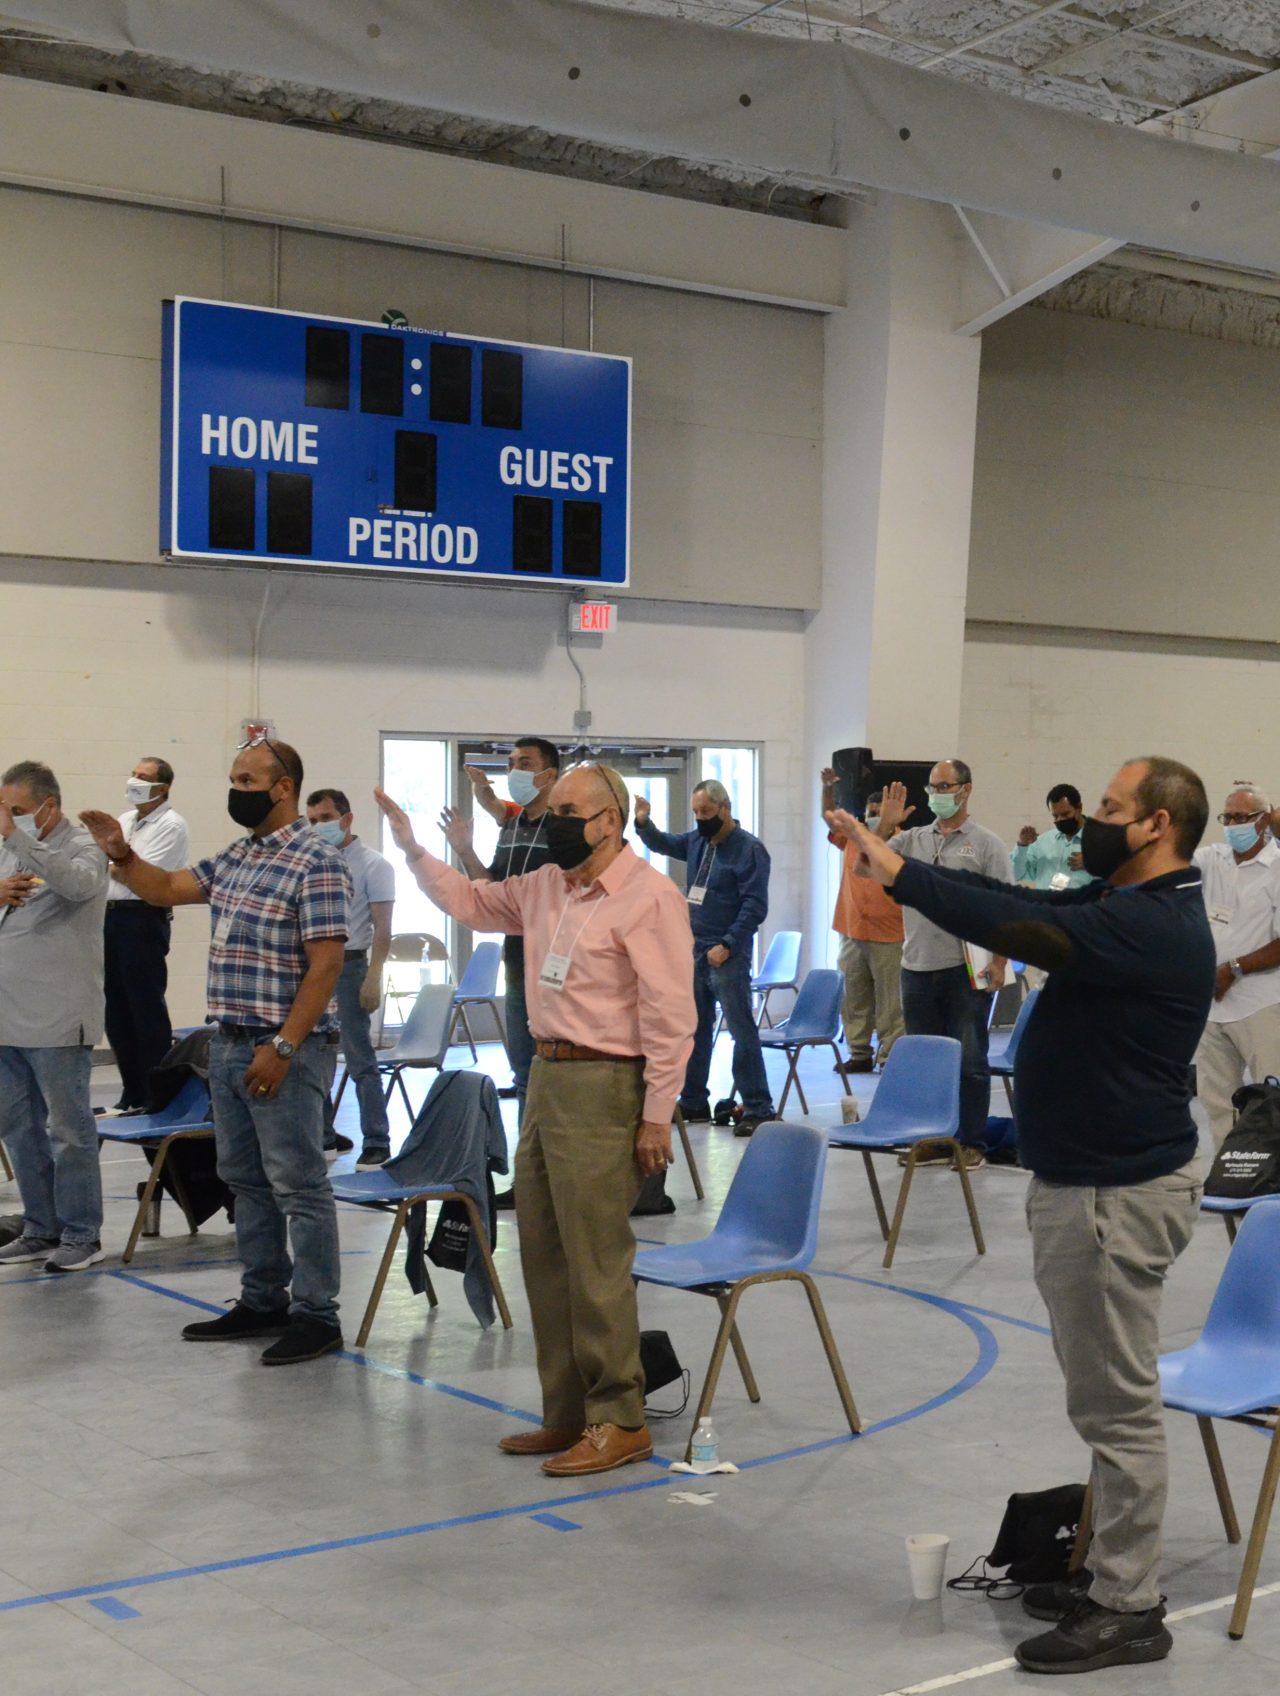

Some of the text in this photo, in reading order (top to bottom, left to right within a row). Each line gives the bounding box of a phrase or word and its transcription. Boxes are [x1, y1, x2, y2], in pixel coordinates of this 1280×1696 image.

[391, 323, 444, 337] DAKTRONICS
[201, 413, 319, 465] HOME
[499, 445, 614, 493] GUEST
[348, 517, 479, 565] PERIOD
[580, 604, 611, 630] EXIT
